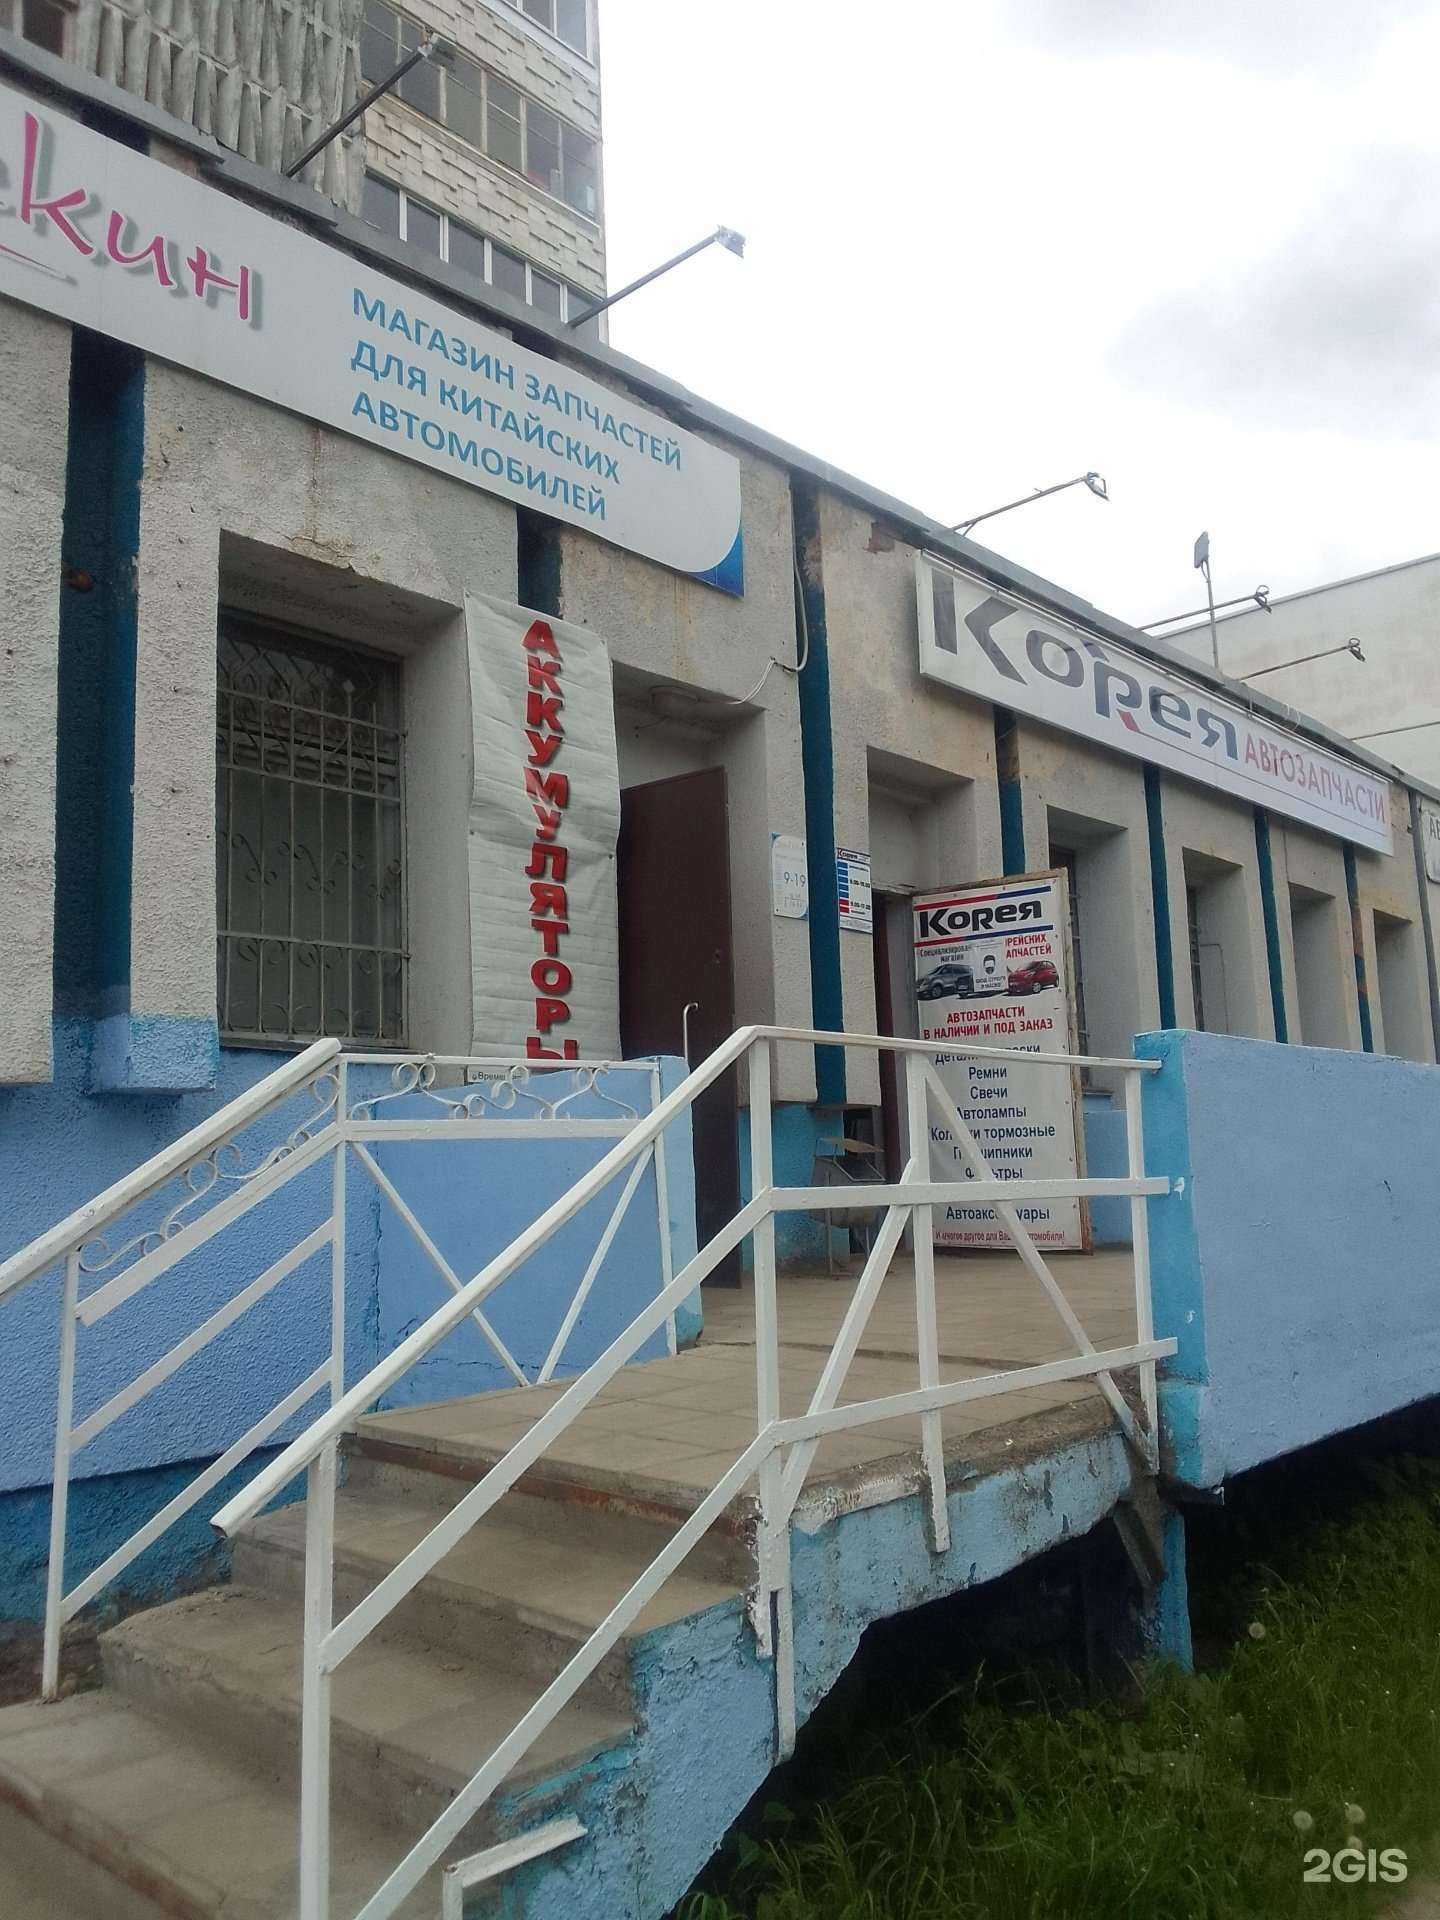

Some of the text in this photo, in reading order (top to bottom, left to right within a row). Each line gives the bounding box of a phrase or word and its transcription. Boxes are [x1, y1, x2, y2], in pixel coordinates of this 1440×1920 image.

[0, 111, 249, 320] кин
[353, 287, 682, 472] МАГАЗИН ЗАПЧАСТЕЙ
[350, 339, 621, 485] ДЛЯ КИТАЙСКИХ
[352, 391, 606, 521] АВТОМОБИЛЕЙ
[1245, 733, 1386, 824] АВТОЗАПЧАСТИ
[521, 619, 578, 1068] АККУМУЛЯТОРЫ
[1006, 943, 1052, 960] АПЧАСТЕЙ
[947, 1005, 1025, 1024] АВТОЗАПЧАСТИ
[923, 1018, 1054, 1040] В НАЛИЧИИ И ПОД ЗАКАЗ
[968, 1066, 1007, 1080] Ремни
[970, 1086, 1008, 1100] Свечи
[985, 1125, 1056, 1143] тормозные
[946, 1206, 1050, 1222] Автоаксуары
